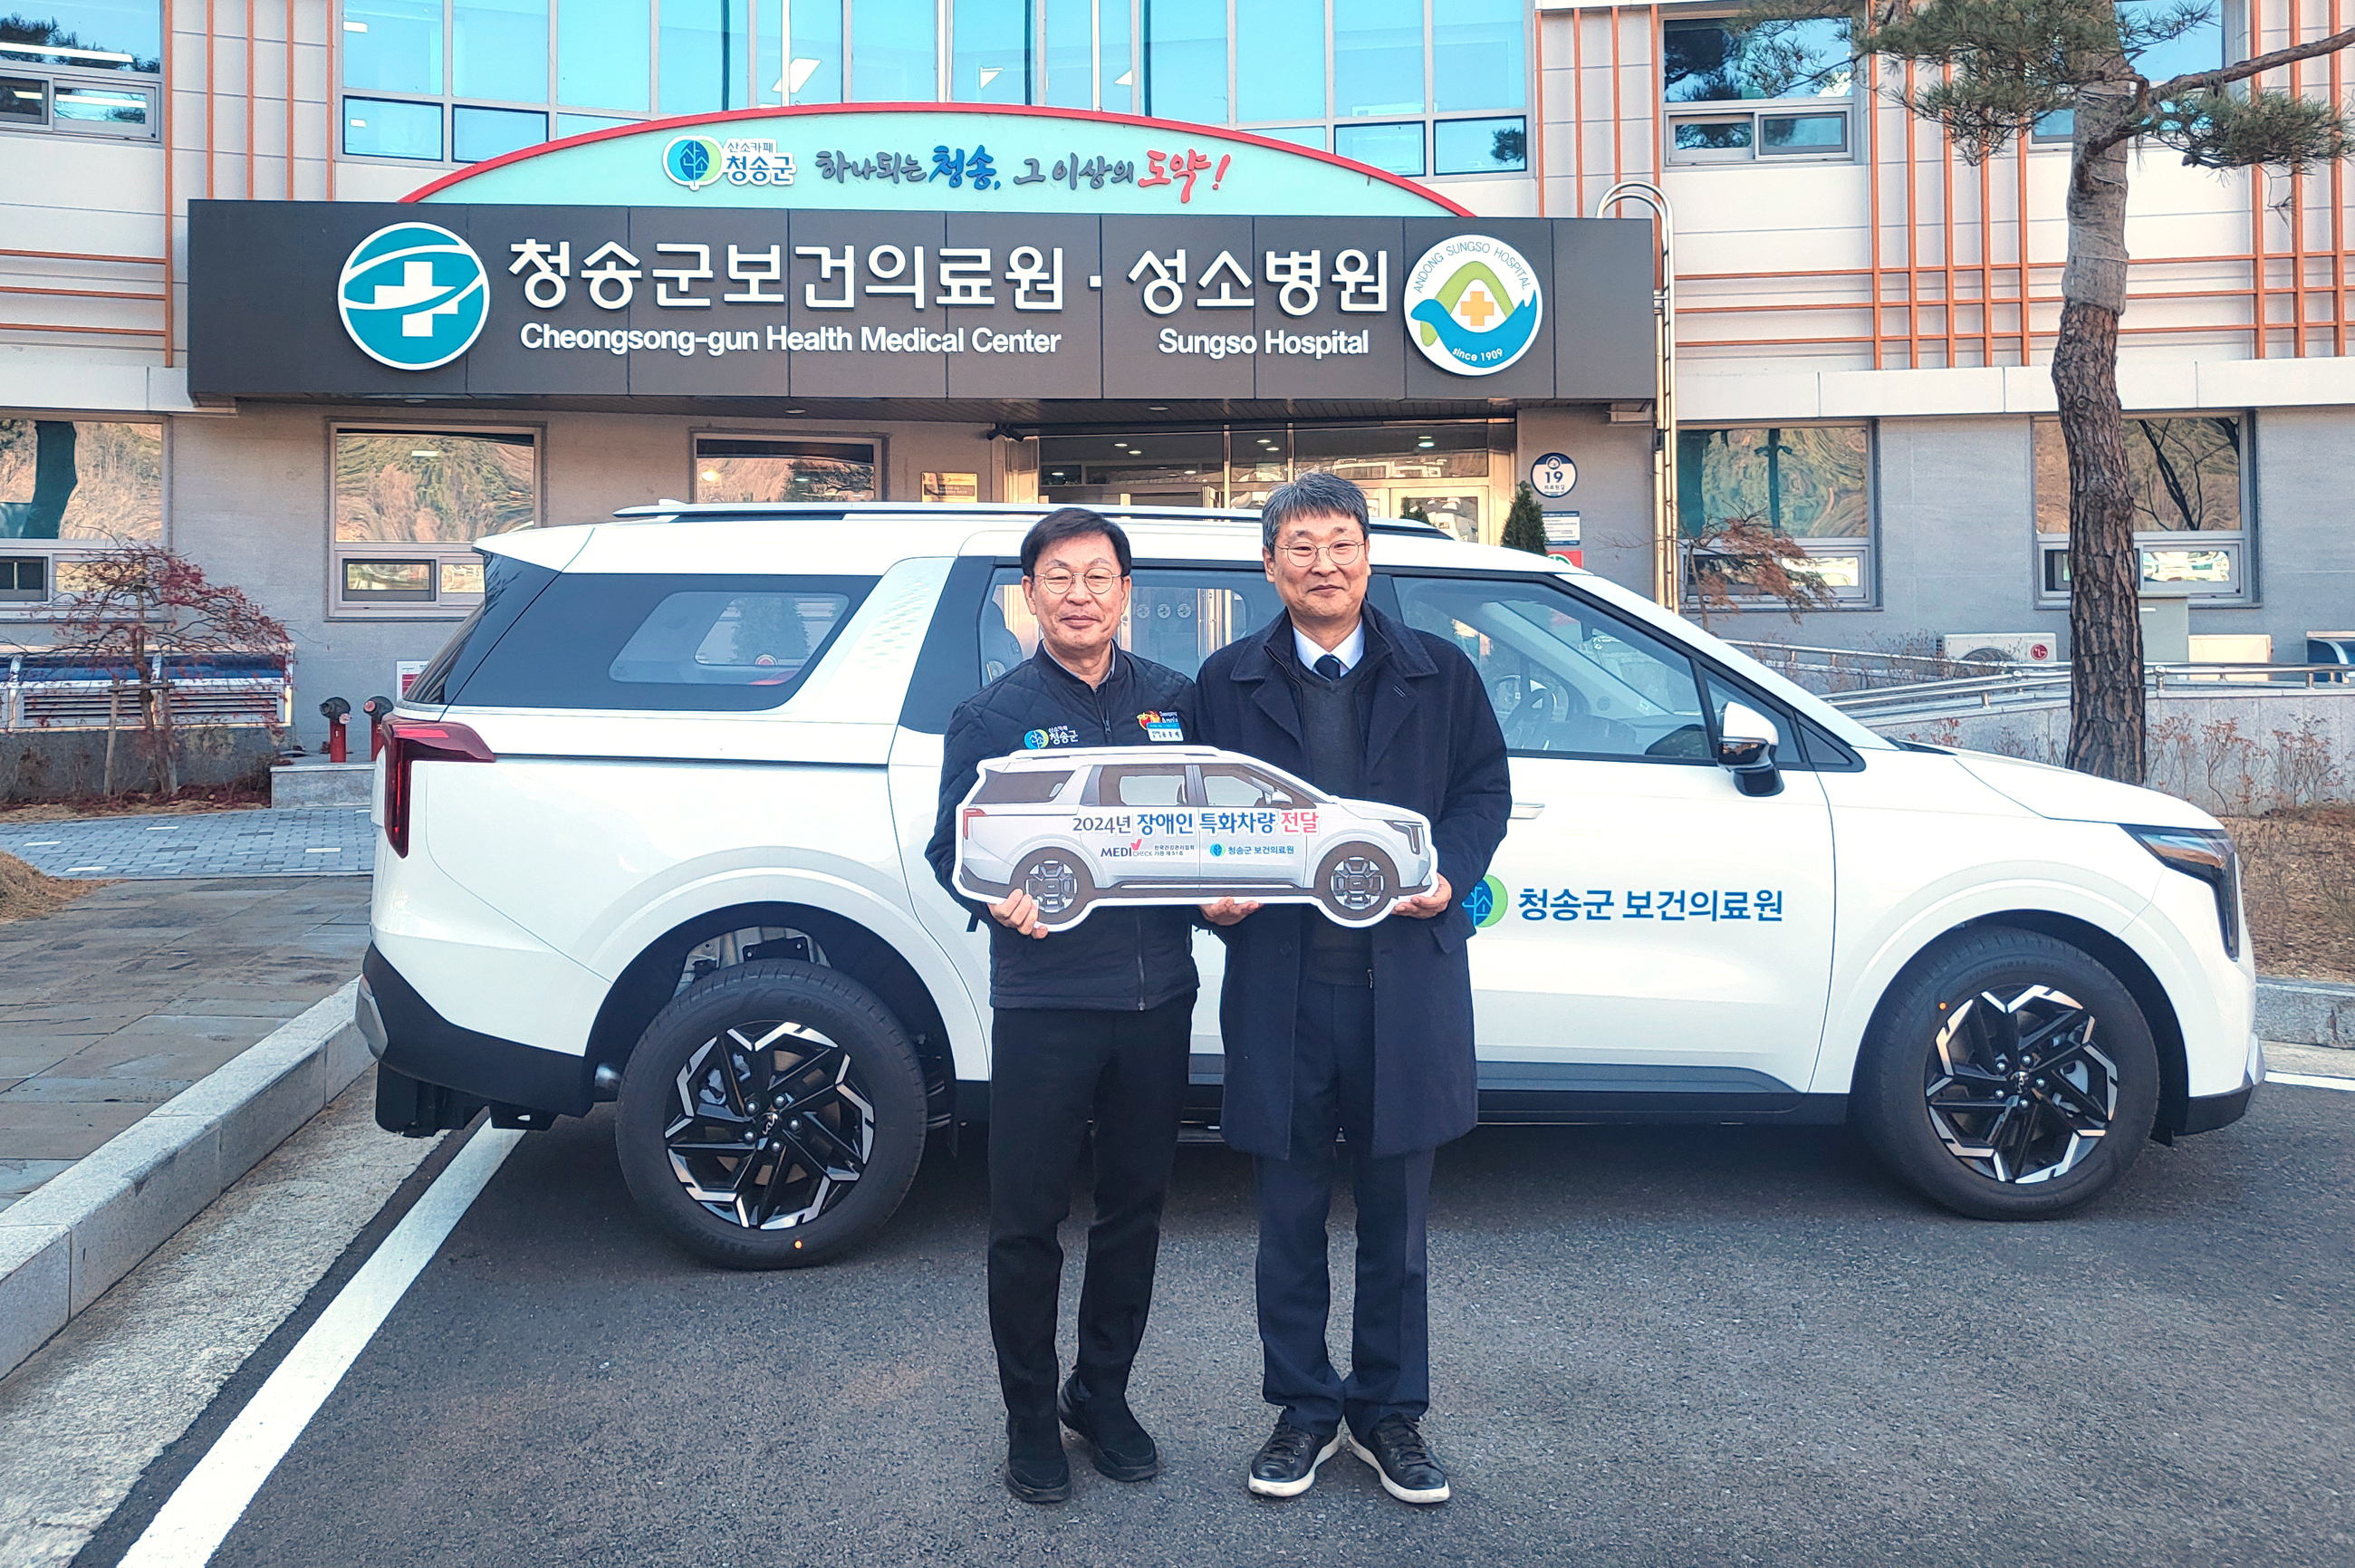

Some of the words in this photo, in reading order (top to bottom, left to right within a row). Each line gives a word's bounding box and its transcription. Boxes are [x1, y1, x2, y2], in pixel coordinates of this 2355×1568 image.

[727, 142, 774, 153] 산소카페
[726, 156, 793, 182] 청송군
[814, 149, 928, 184] 하나되는
[928, 144, 1001, 190] 청송,
[1013, 158, 1046, 186] 그
[1052, 152, 1134, 190] 이상의
[1138, 149, 1231, 203] 도약!
[508, 238, 1064, 311] 청송군보건의료원
[1128, 248, 1388, 316] 성소병원
[1413, 252, 1445, 293] ANDONG
[1446, 241, 1491, 256] SUNGSO
[1494, 247, 1532, 291] HOSPITAL
[520, 322, 759, 357] Cheongsong-gun
[766, 325, 853, 352] Health
[860, 326, 965, 353] Medical
[971, 327, 1062, 353] Center
[1158, 328, 1257, 360] Sungso
[1264, 330, 1369, 360] Hospital
[1452, 348, 1478, 361] since
[1480, 348, 1504, 361] 1909
[1544, 470, 1563, 484] 19
[1049, 729, 1078, 745] 청송군
[1072, 816, 1131, 834] 2024년
[1137, 813, 1194, 835] 장애인
[1198, 812, 1276, 833] 특화차량
[1281, 812, 1319, 833] 전달
[1227, 845, 1253, 855] 청송군
[1254, 845, 1294, 855] 보건의료원
[1518, 888, 1615, 921] 청송군
[1622, 890, 1783, 922] 보건의료원
